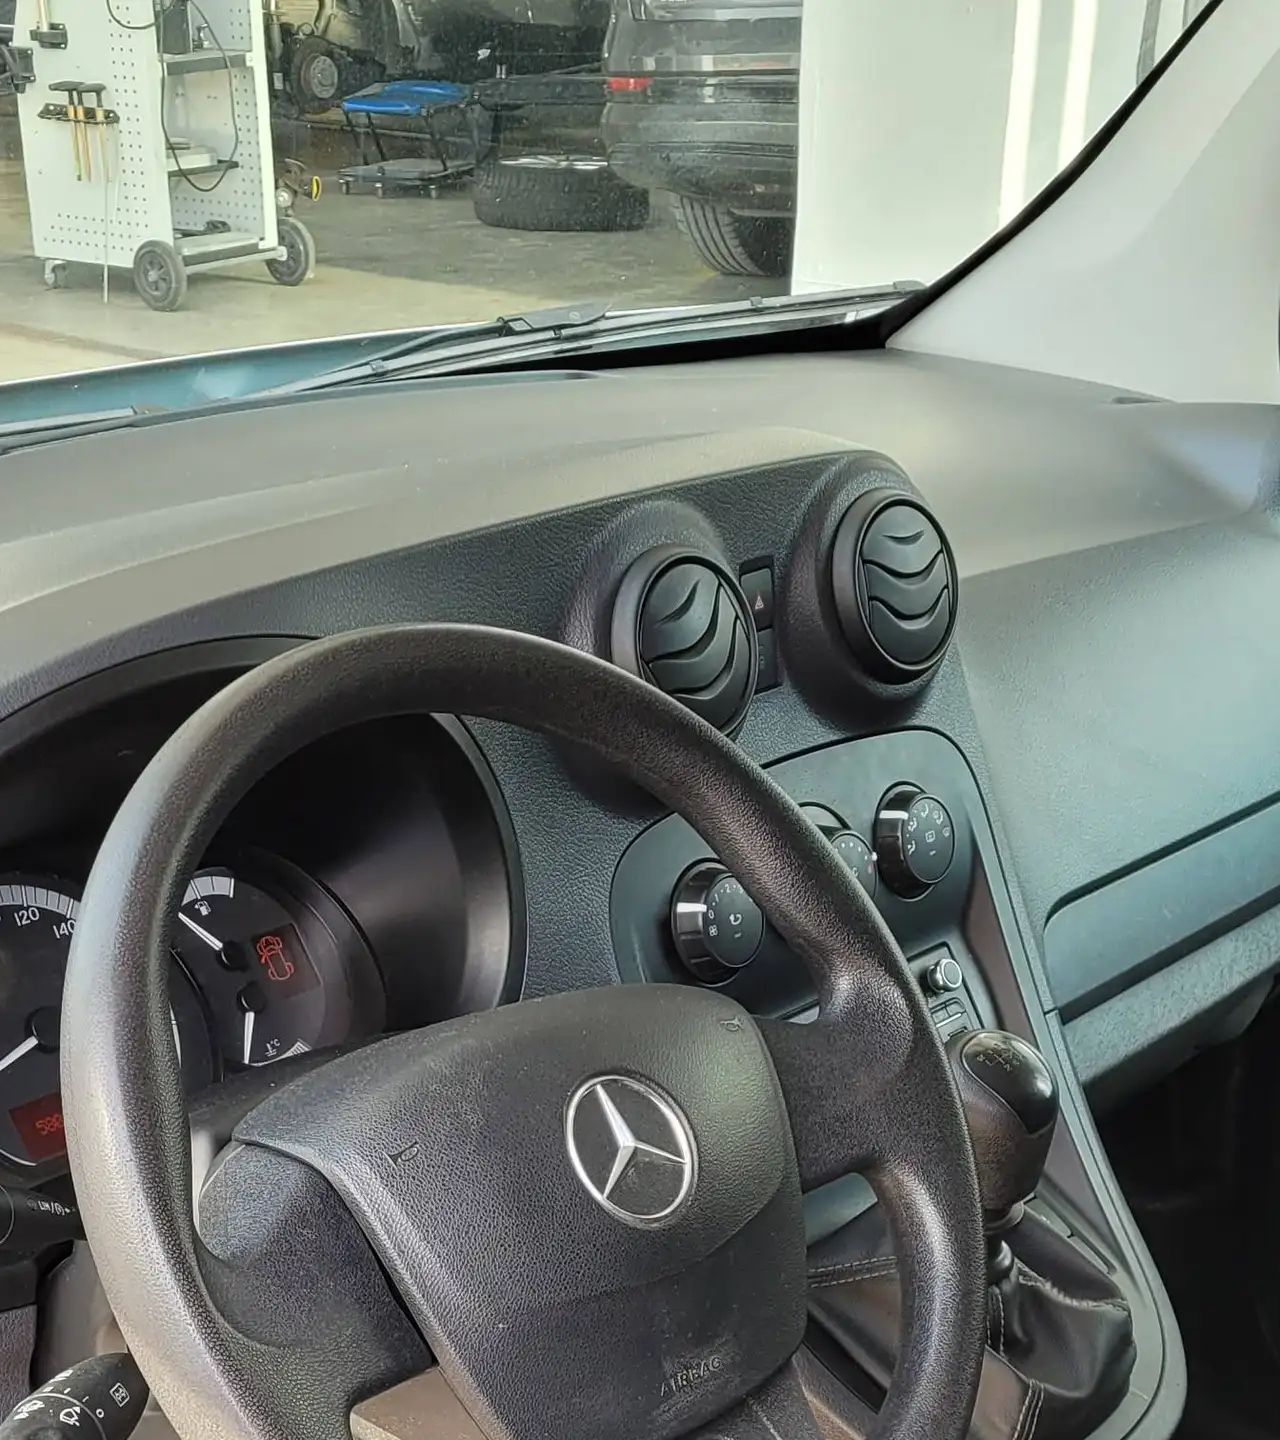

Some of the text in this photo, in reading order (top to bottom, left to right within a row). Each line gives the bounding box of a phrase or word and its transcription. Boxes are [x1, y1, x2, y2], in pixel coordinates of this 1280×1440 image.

[724, 883, 732, 894] 2
[13, 907, 40, 927] 120
[52, 919, 76, 939] 140
